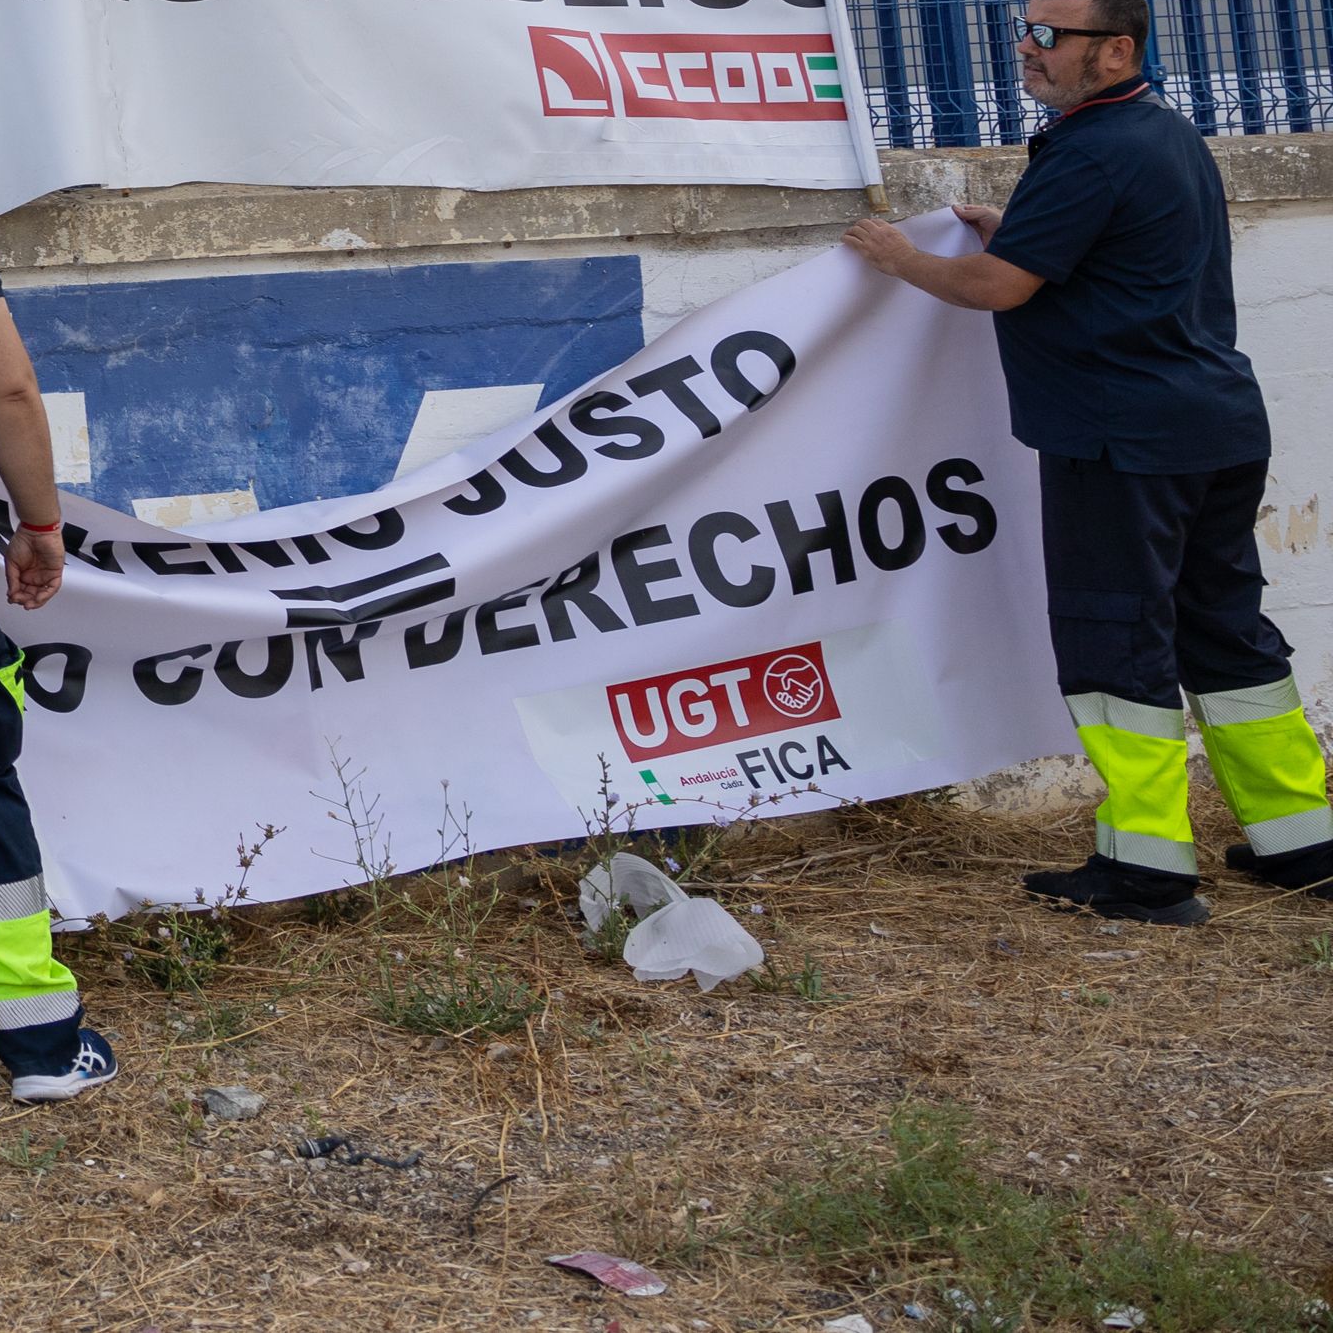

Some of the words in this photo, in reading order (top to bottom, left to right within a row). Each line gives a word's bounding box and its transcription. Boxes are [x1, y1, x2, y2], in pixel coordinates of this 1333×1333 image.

[441, 329, 797, 517] JUSTO
[131, 619, 383, 707] CON
[403, 457, 998, 670] DERECHOS
[613, 666, 752, 750] UGT
[679, 767, 739, 787] Andalucía
[720, 779, 745, 791] Cádiz
[735, 734, 852, 790] FICA
